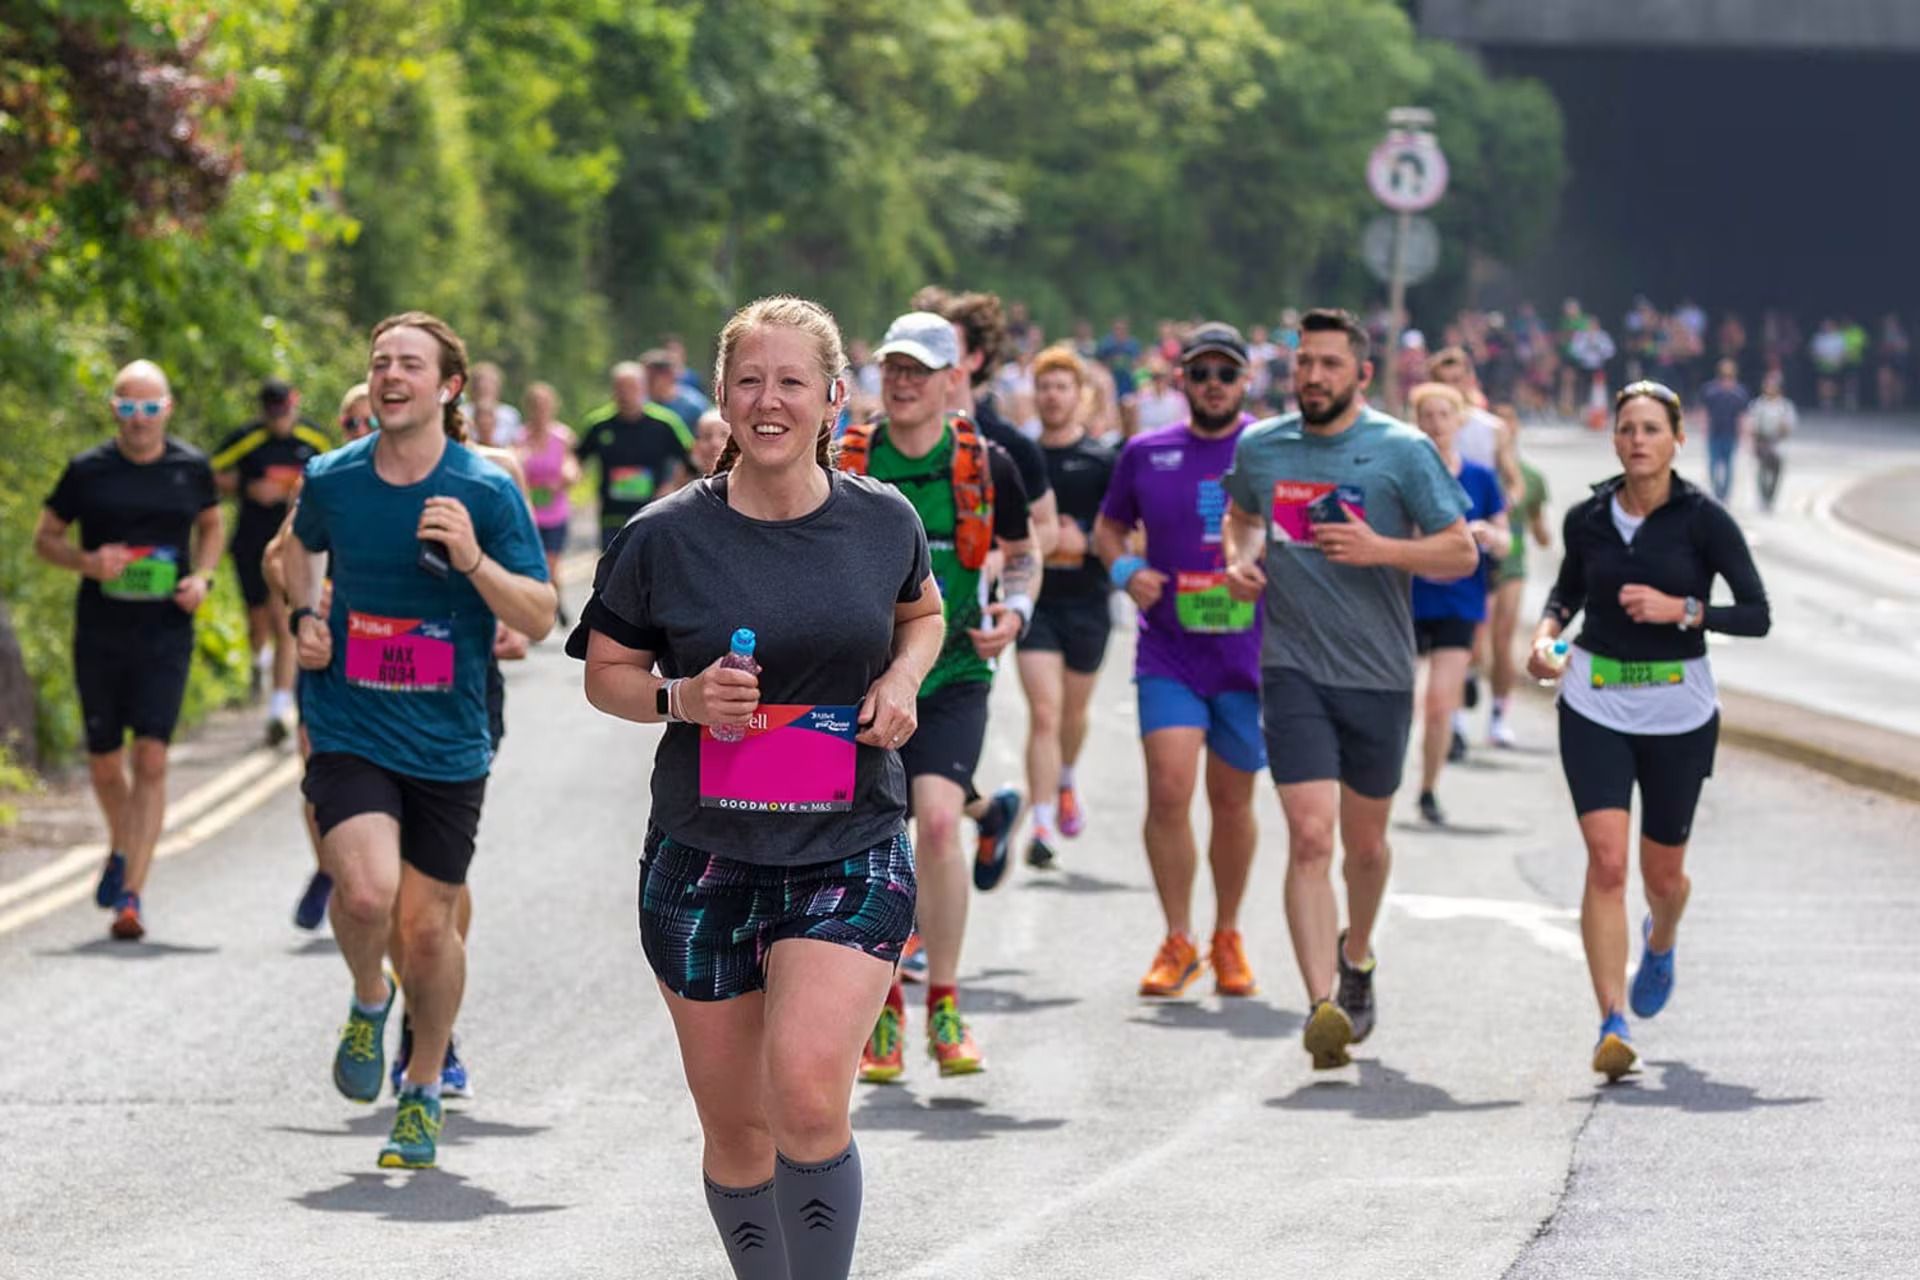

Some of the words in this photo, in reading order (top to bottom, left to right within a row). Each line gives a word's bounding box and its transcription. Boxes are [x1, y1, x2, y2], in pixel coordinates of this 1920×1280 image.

[383, 647, 414, 663] MAX
[750, 713, 767, 729] ell
[720, 799, 795, 811] GOODMOVE
[811, 803, 831, 811] M&S
